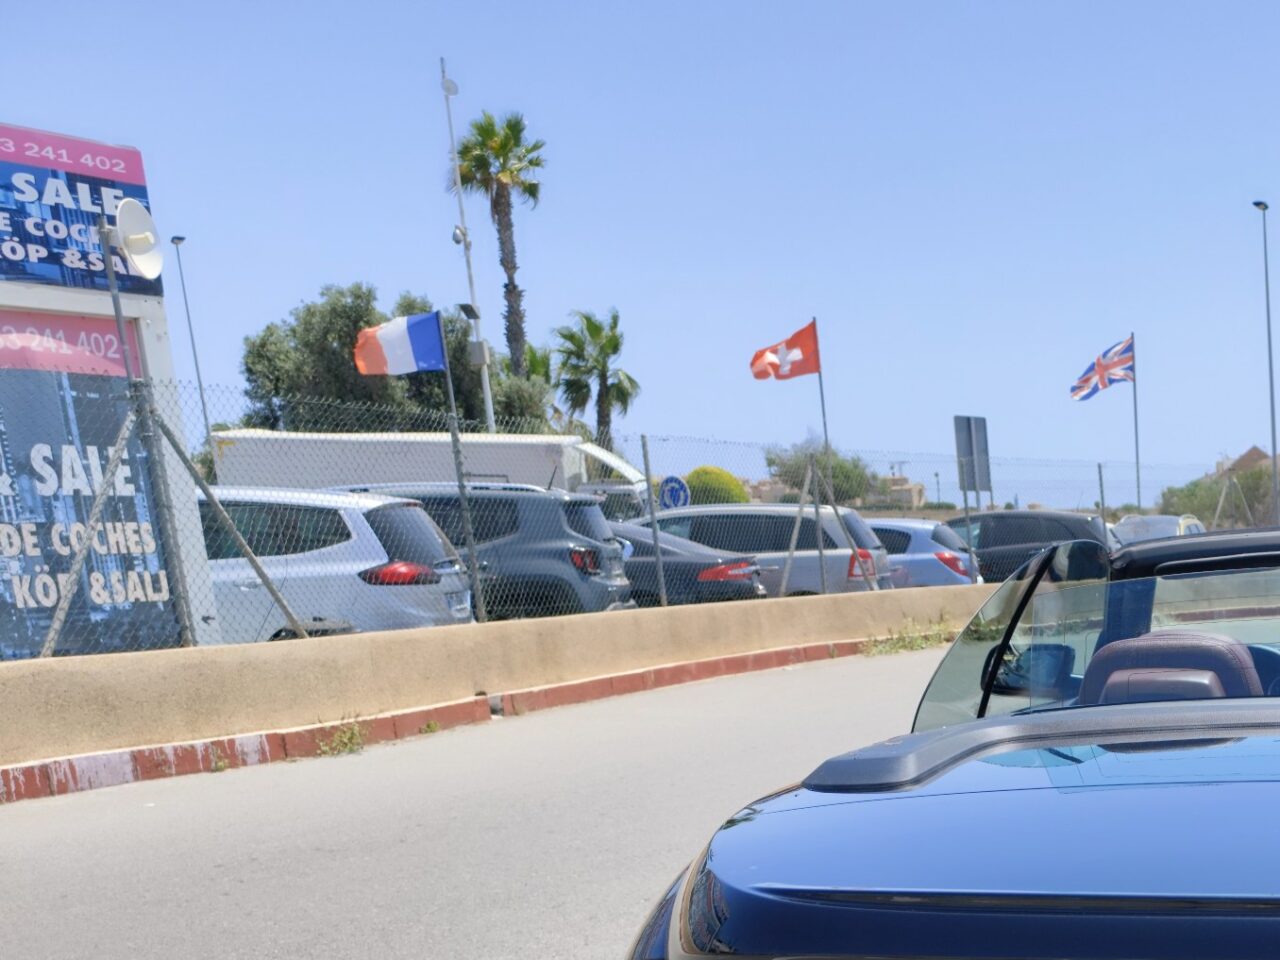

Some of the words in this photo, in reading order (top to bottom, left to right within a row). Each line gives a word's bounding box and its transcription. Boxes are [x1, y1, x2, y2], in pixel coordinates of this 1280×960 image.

[24, 142, 74, 164] 241
[80, 153, 127, 174] 402
[11, 172, 124, 216] SALE
[0, 235, 49, 263] ÖP
[25, 326, 73, 355] 241
[77, 331, 121, 359] 402
[30, 443, 136, 497] SALE
[51, 521, 157, 557] COCHES
